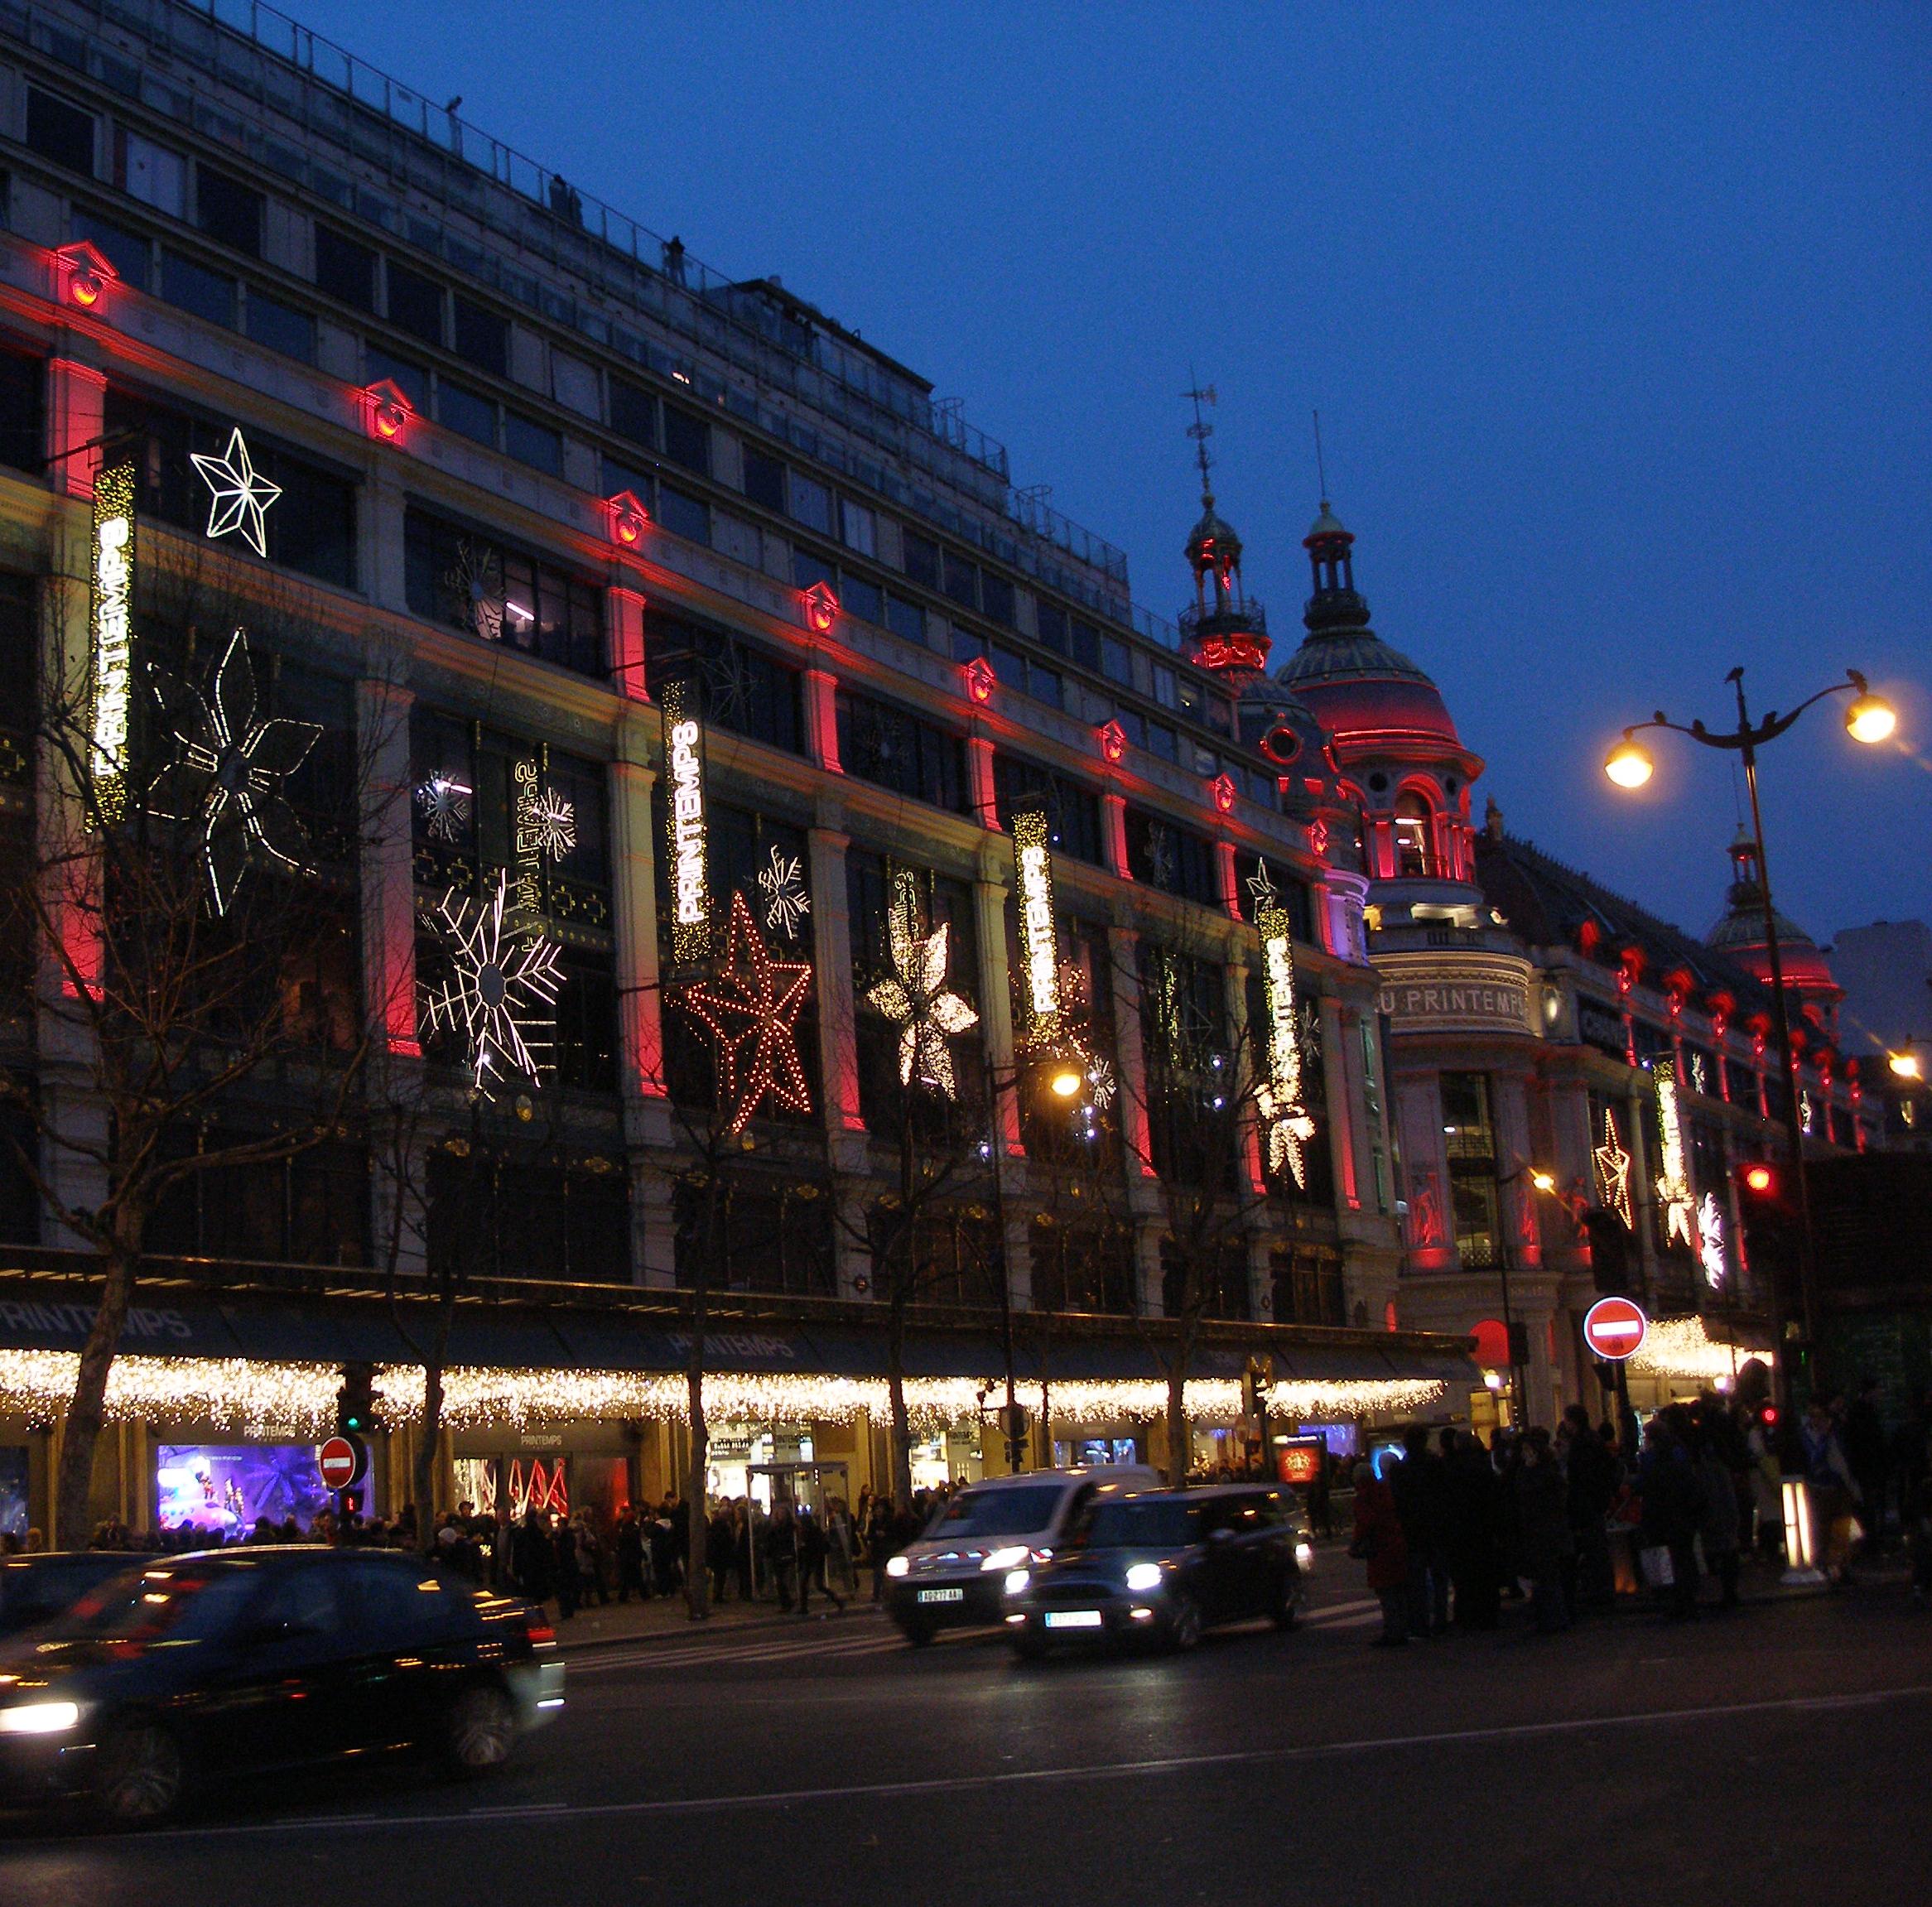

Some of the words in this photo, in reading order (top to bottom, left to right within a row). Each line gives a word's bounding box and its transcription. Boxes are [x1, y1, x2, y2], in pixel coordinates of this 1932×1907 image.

[94, 515, 129, 777] PRINTEMPS
[672, 720, 705, 925] PRINTEMPS
[1021, 845, 1058, 1014] PRINTEMPS
[1406, 989, 1525, 1016] PRINTEMPS
